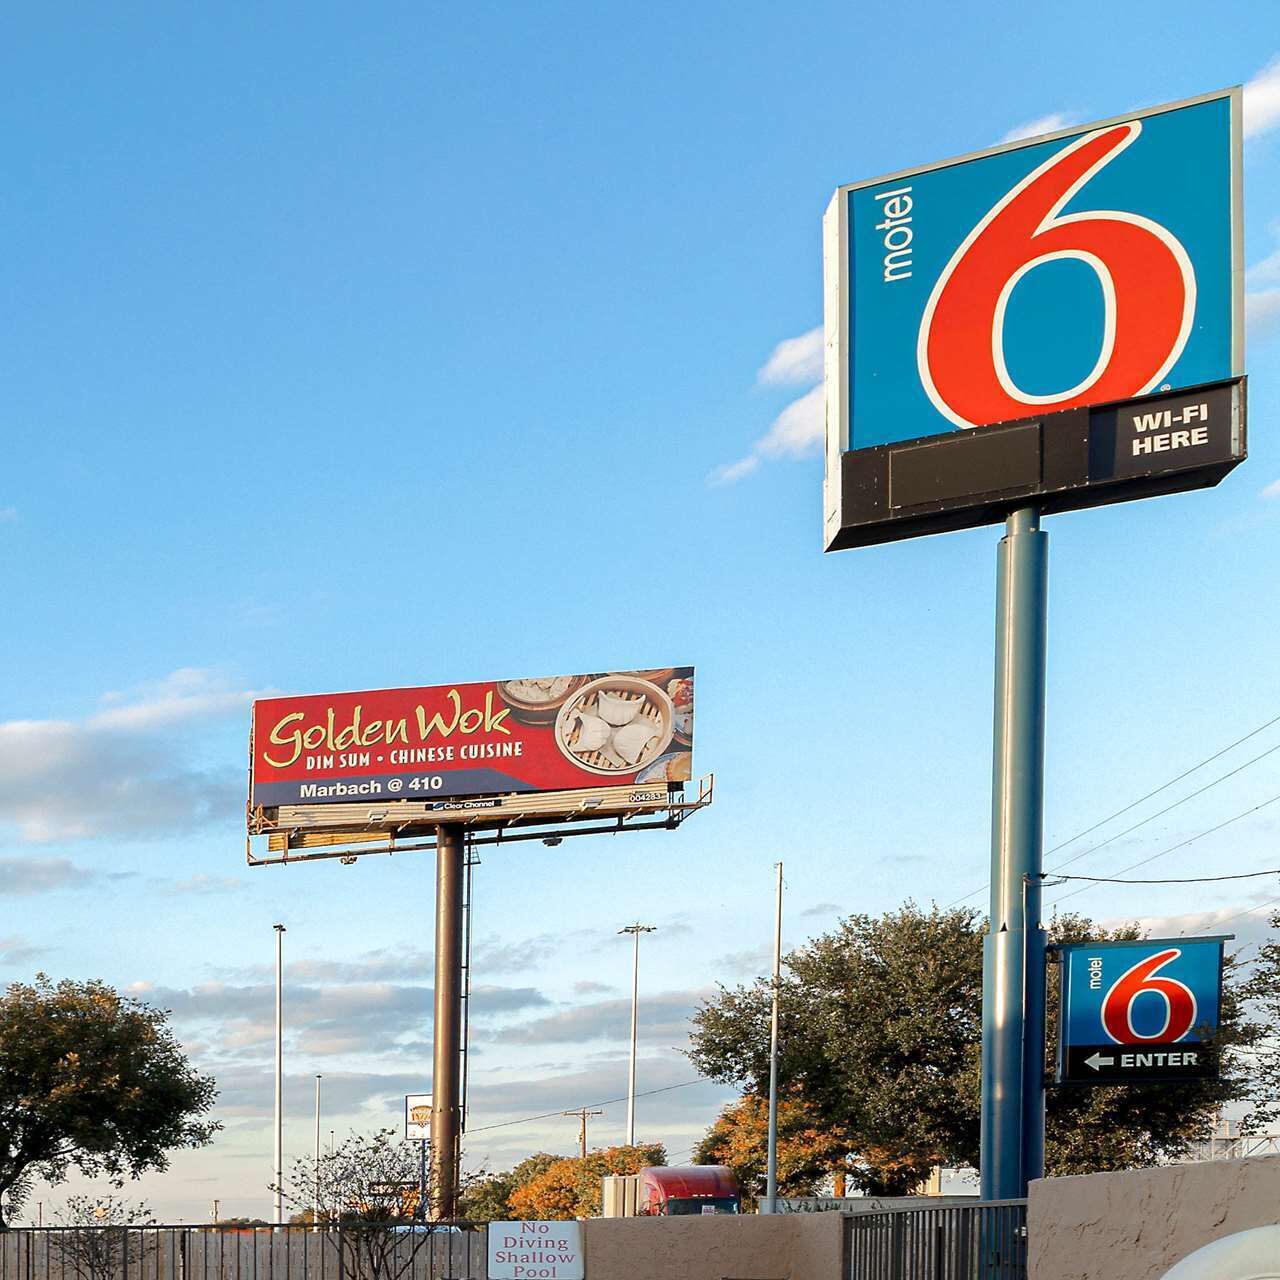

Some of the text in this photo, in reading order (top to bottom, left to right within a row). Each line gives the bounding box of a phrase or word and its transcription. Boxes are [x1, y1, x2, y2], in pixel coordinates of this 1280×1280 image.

[875, 119, 1197, 429] motel 6
[1133, 403, 1208, 433] WI-FI
[1132, 426, 1208, 456] HERE
[263, 688, 512, 768] Golden Wok
[306, 740, 523, 771] DIM SUM CHINESE CUISINE
[300, 776, 443, 798] Marbach @ 410
[464, 801, 495, 809] Channel
[1088, 948, 1197, 1045] motel 6
[1120, 1052, 1198, 1068] ENTER
[521, 1222, 549, 1234] No
[504, 1236, 568, 1251] Diving
[496, 1251, 576, 1264] Shallow
[514, 1265, 557, 1278] Pool
